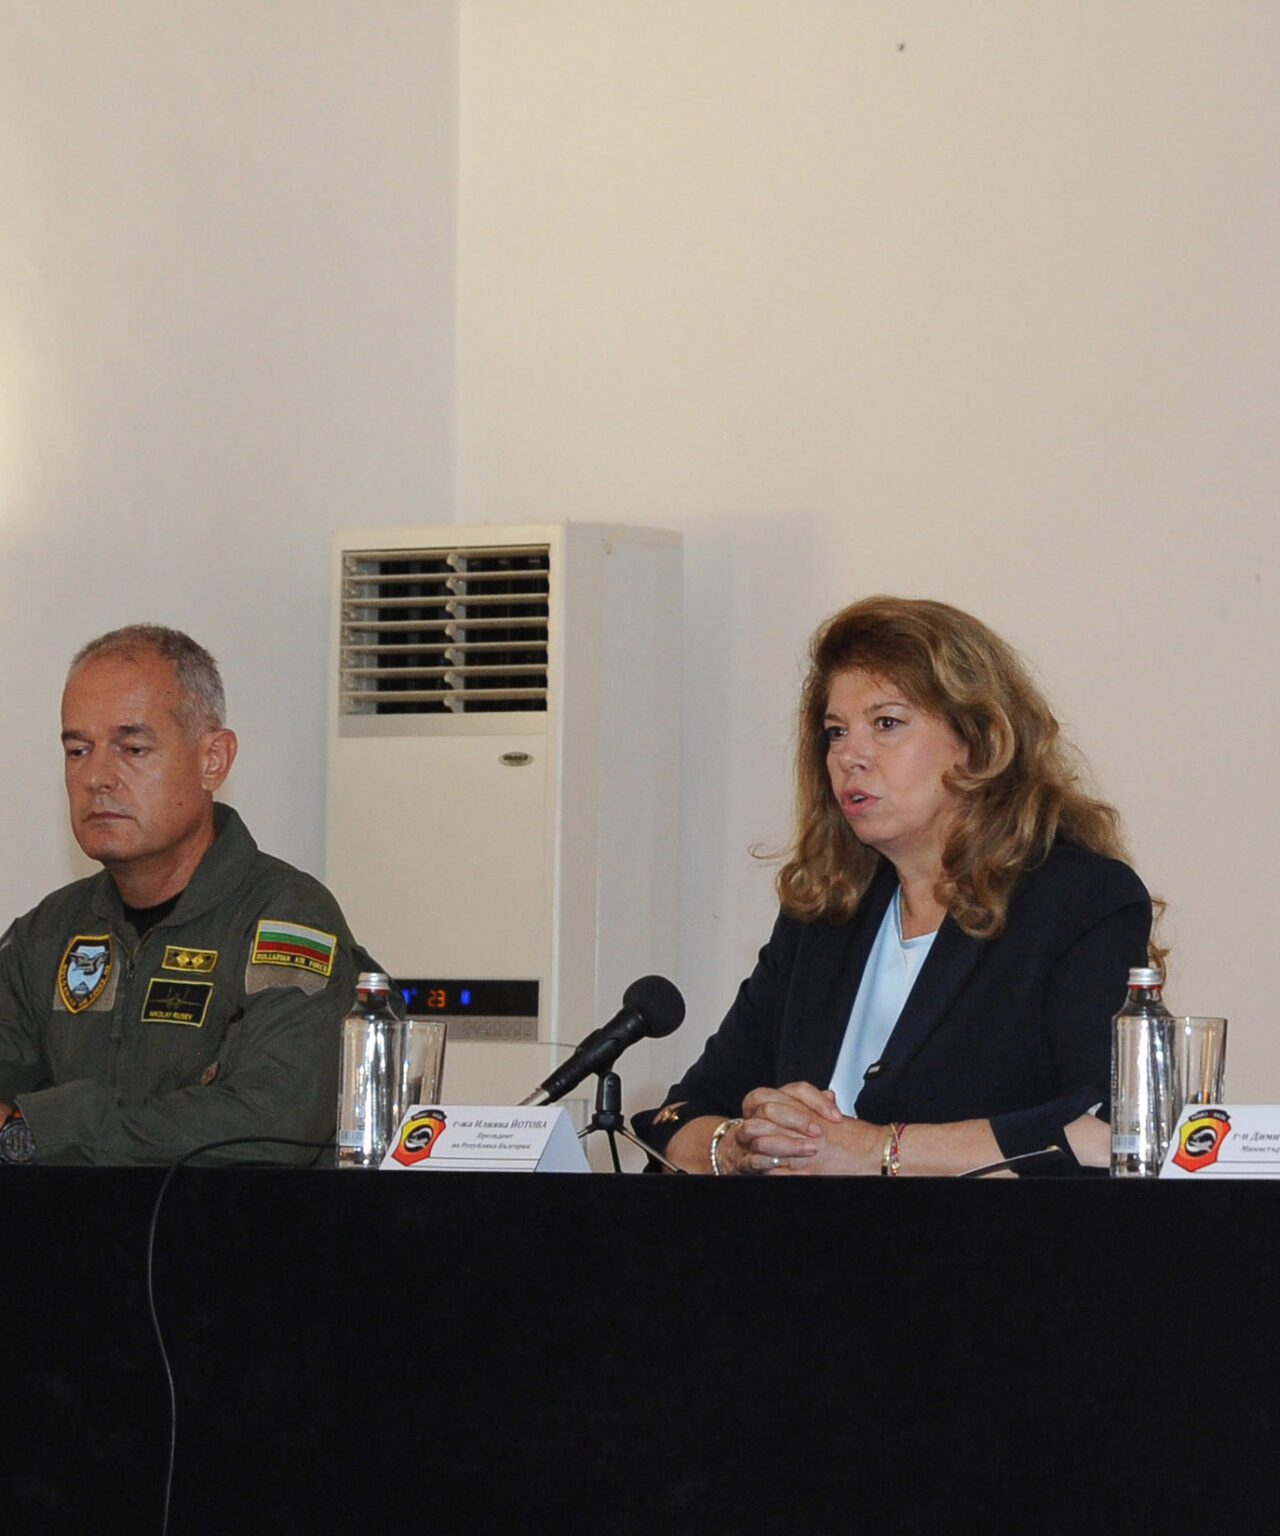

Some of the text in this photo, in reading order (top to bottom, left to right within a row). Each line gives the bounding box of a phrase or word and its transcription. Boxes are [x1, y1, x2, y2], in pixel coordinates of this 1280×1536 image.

[427, 989, 447, 1008] 23
[510, 1118, 547, 1129] ЙОТОВА
[1233, 1132, 1249, 1140] г-н
